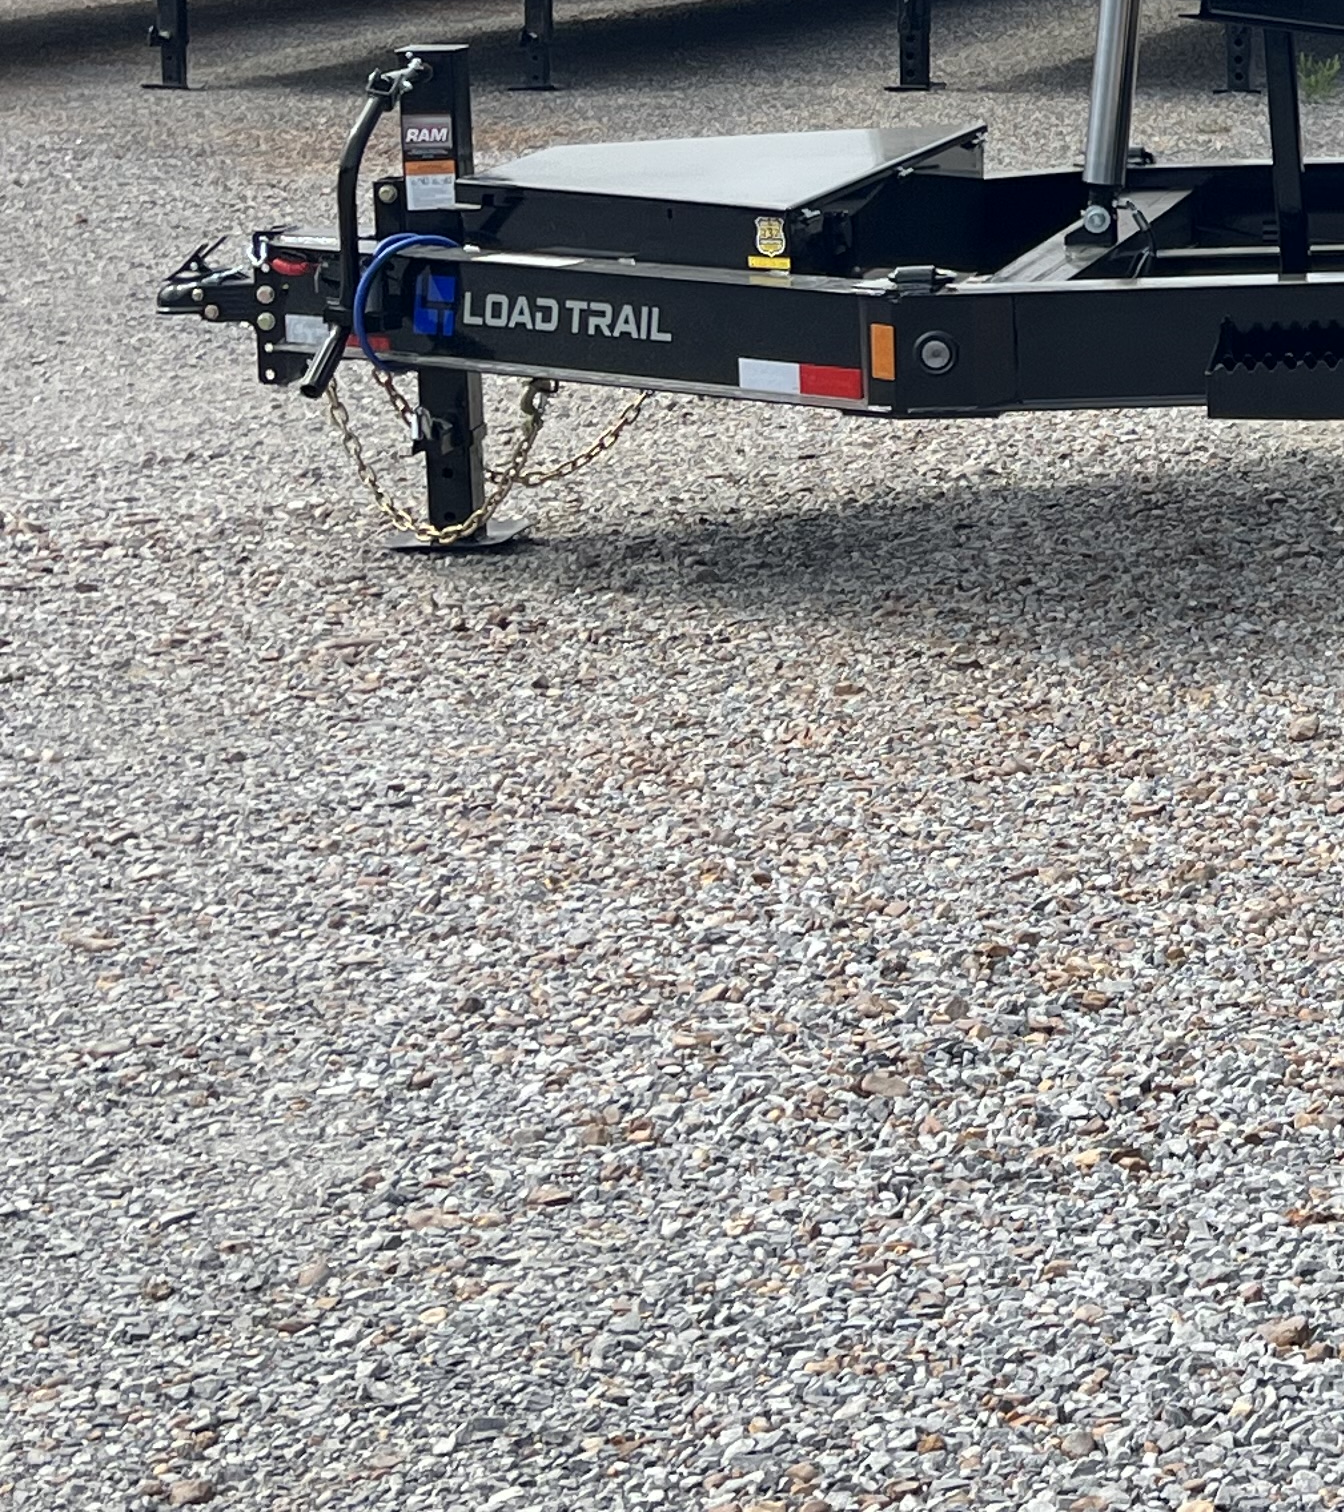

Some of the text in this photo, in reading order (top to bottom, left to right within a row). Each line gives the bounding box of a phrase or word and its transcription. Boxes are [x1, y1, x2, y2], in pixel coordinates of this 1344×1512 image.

[405, 128, 449, 143] RAM
[463, 291, 672, 342] LOAD TRAIL
